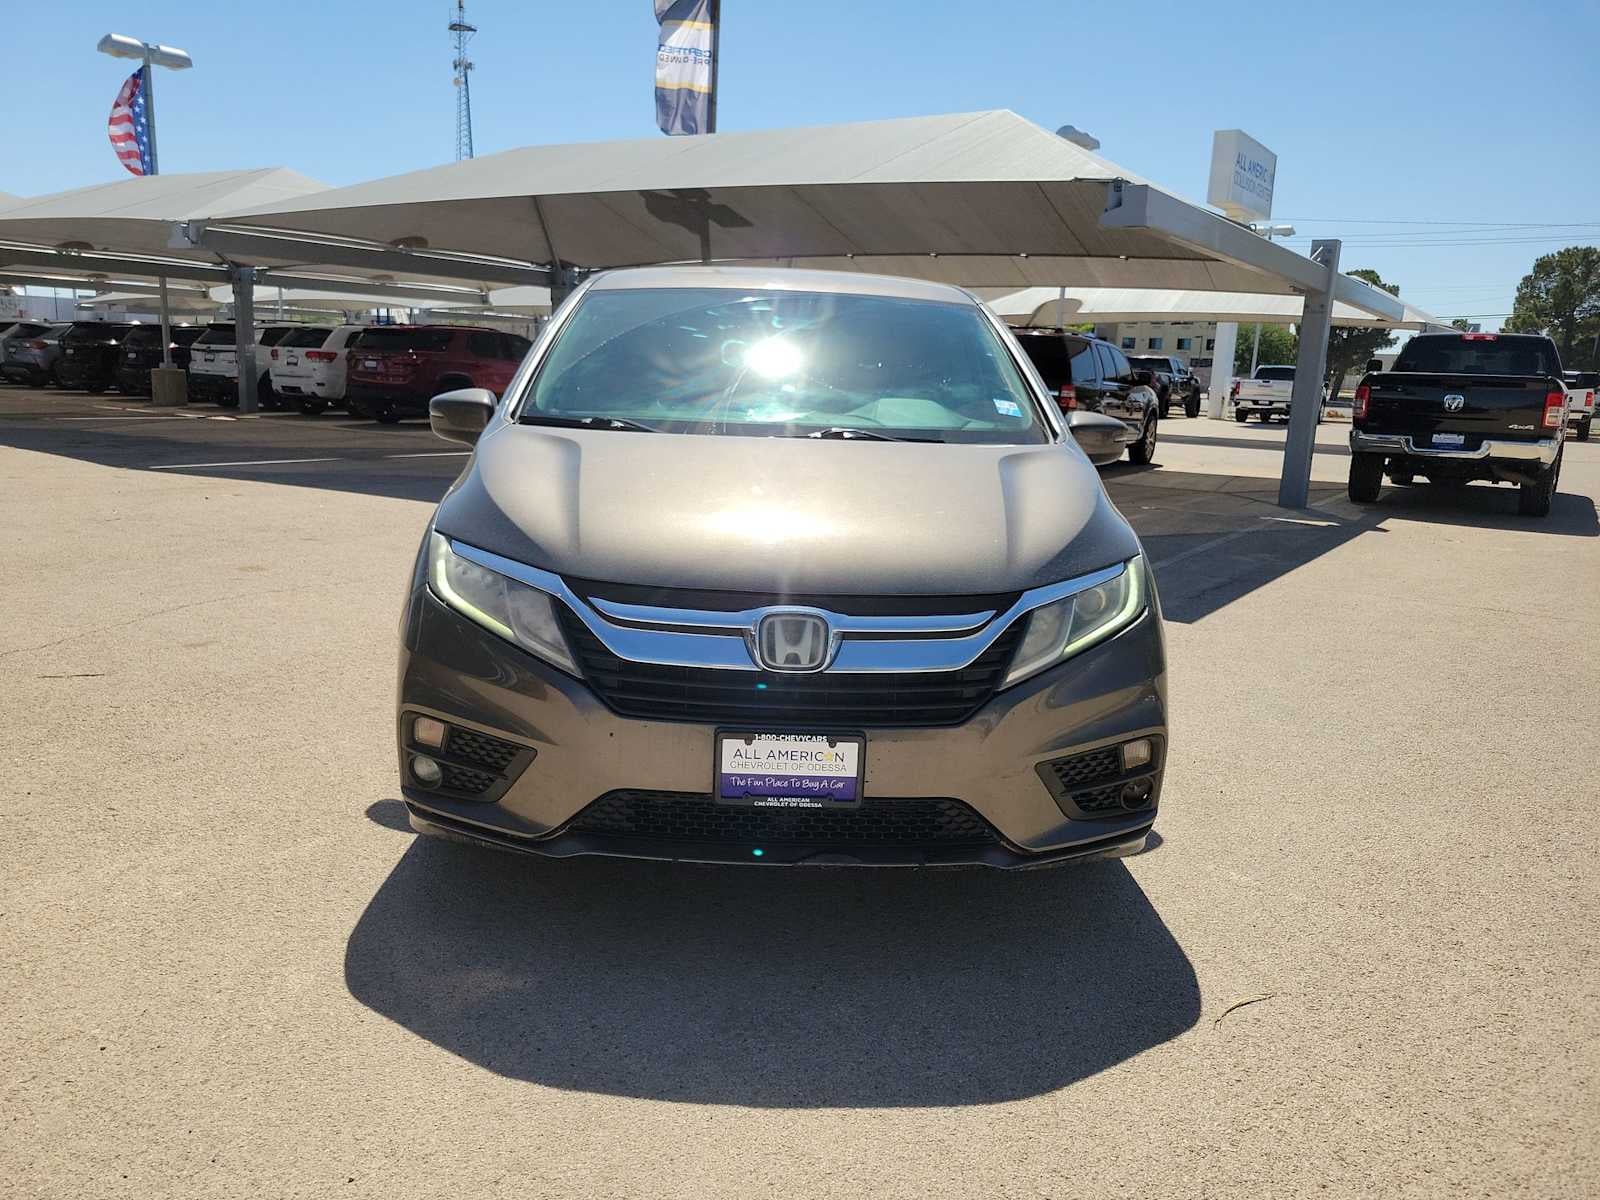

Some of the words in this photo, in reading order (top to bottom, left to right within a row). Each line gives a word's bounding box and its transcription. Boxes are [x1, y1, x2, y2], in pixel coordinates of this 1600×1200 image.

[754, 734, 827, 743] 1-800-CHEVYCARS
[733, 749, 761, 760] ALL
[730, 760, 788, 770] CHEVROLET
[791, 762, 804, 771] OF
[807, 763, 847, 773] ODESSA
[730, 777, 746, 787] The
[748, 777, 763, 787] Fun
[766, 777, 788, 787] Place
[790, 778, 800, 788] To
[802, 779, 819, 791] Buy
[820, 780, 828, 788] A
[830, 780, 845, 789] Car
